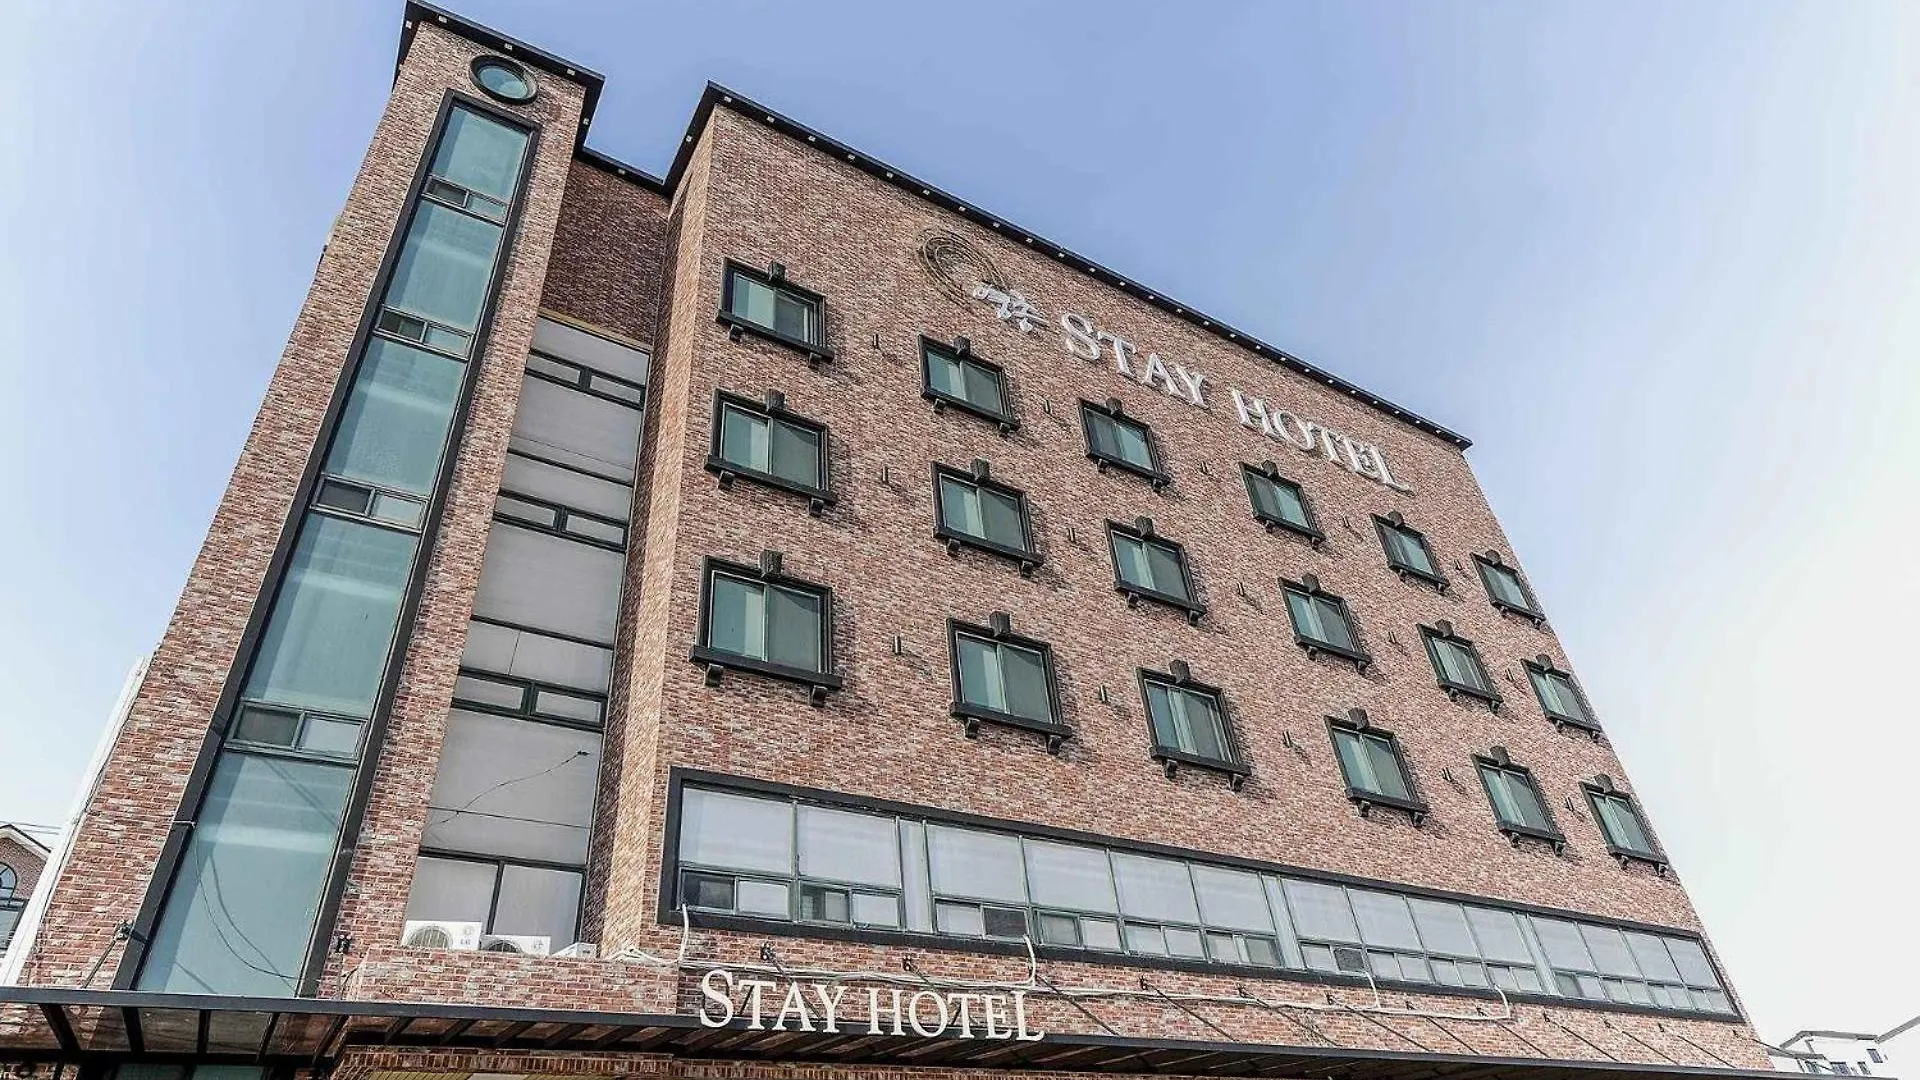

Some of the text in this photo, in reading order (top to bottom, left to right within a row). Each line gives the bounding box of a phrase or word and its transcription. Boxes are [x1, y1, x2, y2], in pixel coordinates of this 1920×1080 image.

[1061, 312, 1414, 496] STAY HOTEL
[699, 970, 1044, 1042] STAY HOTEL
